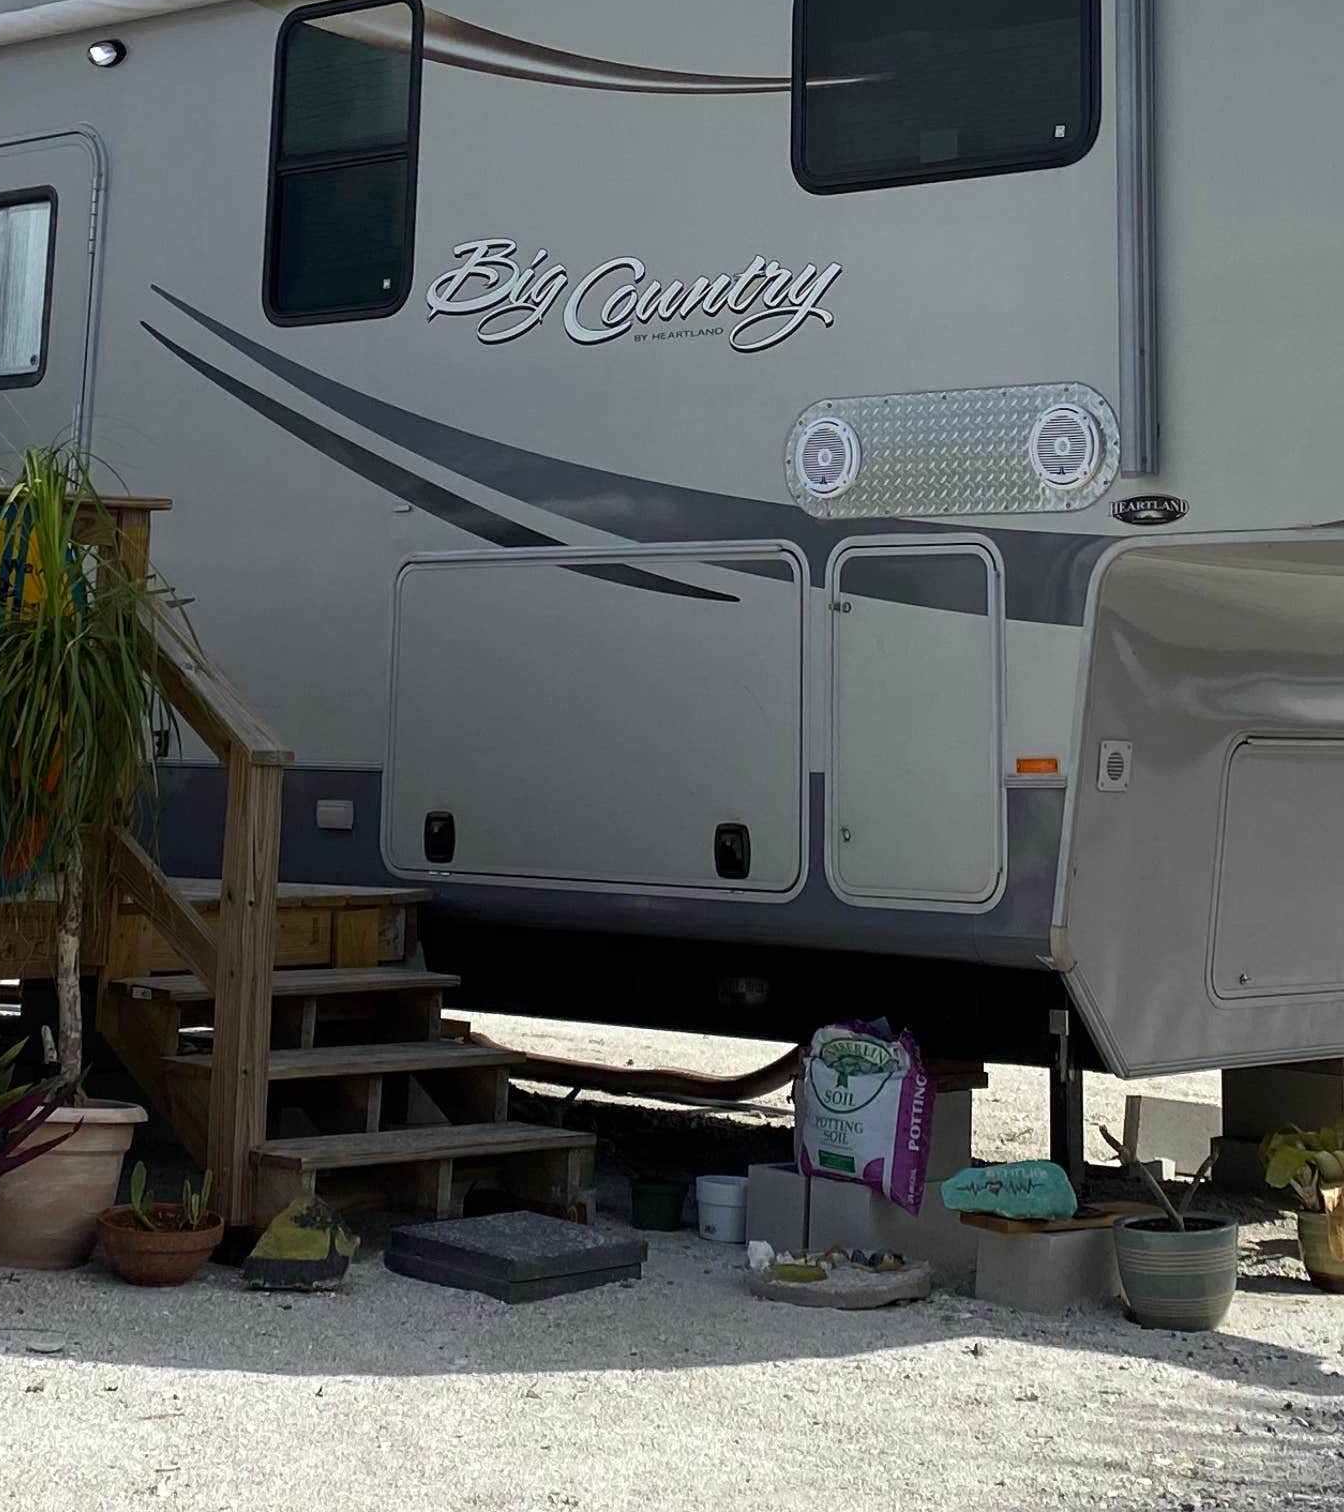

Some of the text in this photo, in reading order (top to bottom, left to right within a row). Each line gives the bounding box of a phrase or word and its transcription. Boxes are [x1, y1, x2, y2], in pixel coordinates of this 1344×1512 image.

[426, 238, 843, 353] Big Country
[633, 327, 724, 343] BY HEARTLAND
[1108, 499, 1190, 518] HEARTLAND
[823, 1089, 856, 1107] SOIL
[908, 1074, 928, 1152] POTTING
[816, 1116, 864, 1134] POTTING
[823, 1130, 849, 1145] SOIL
